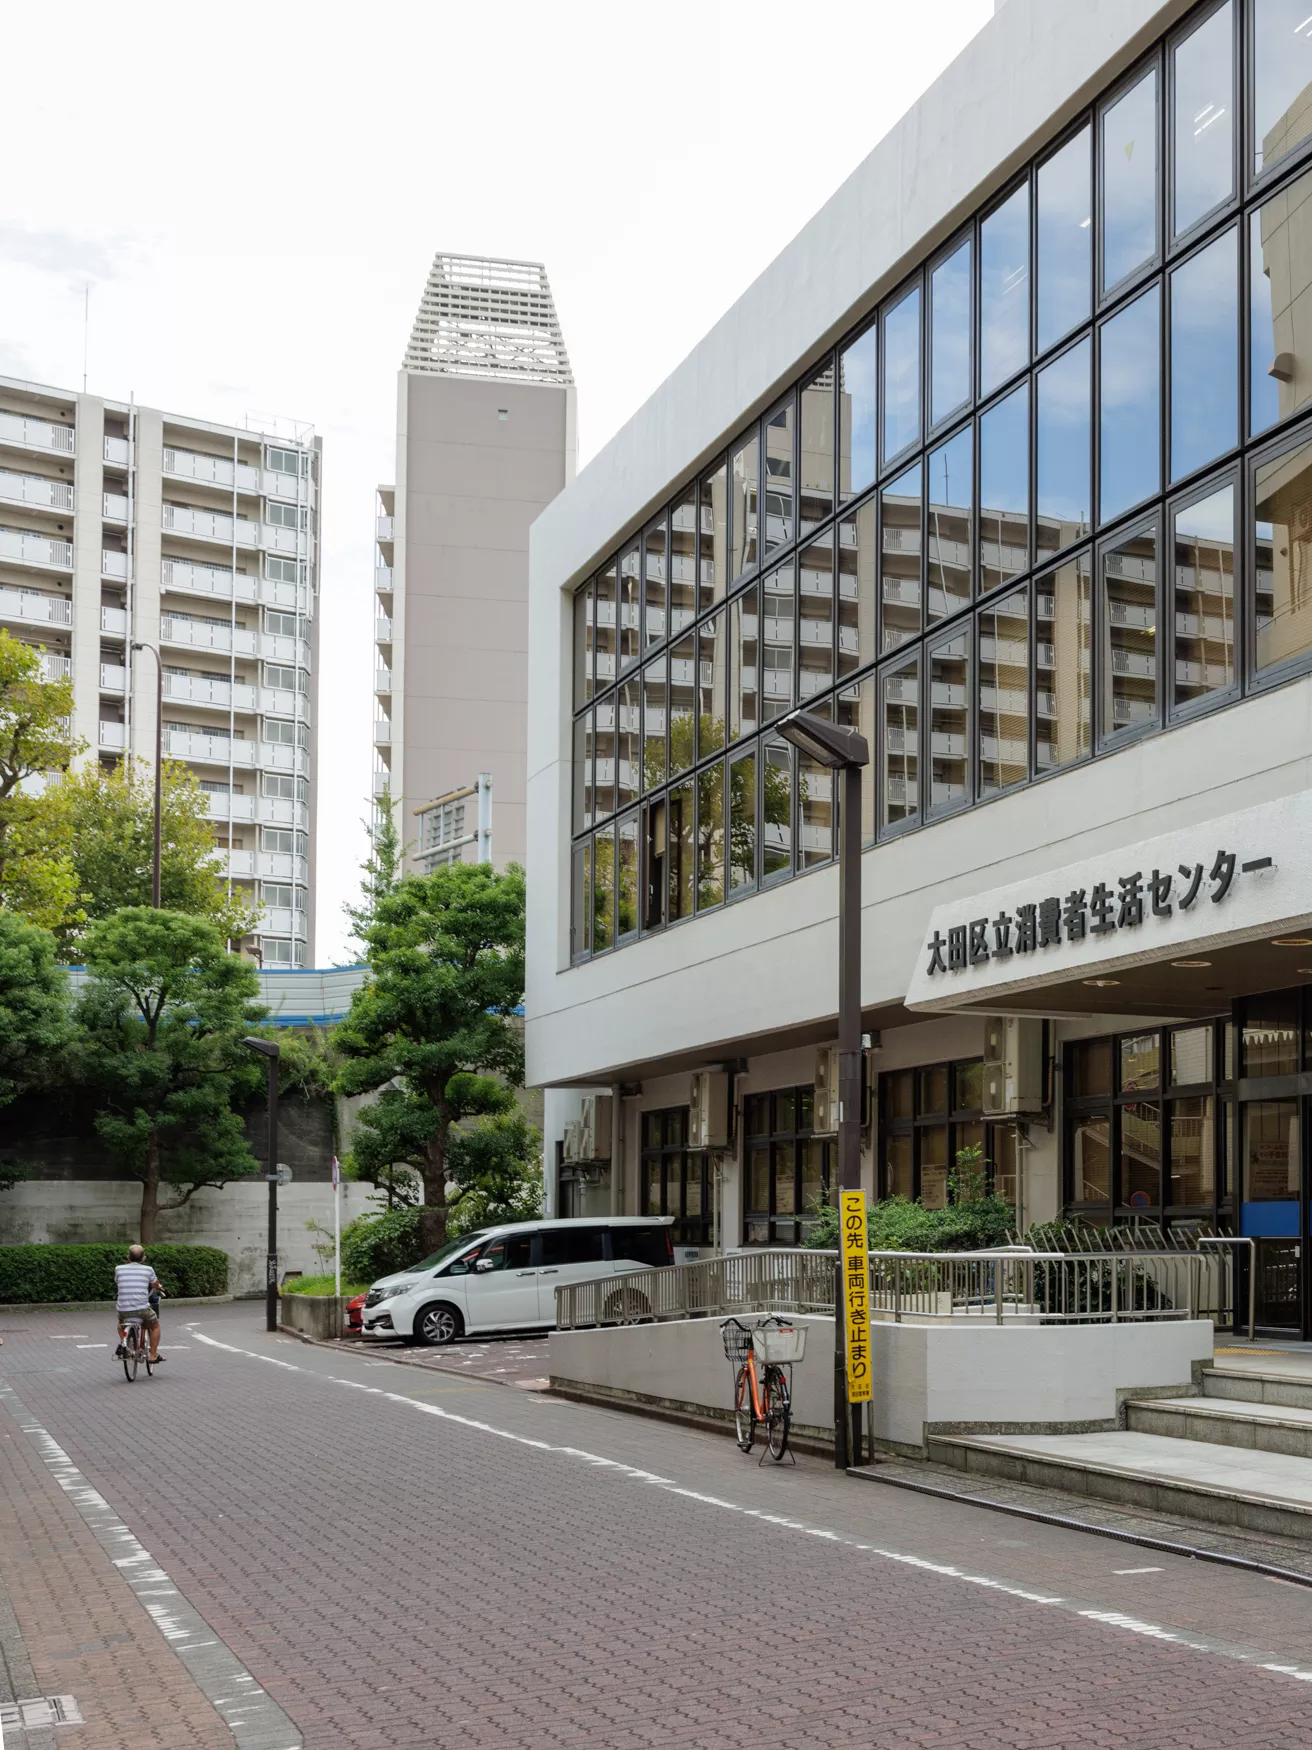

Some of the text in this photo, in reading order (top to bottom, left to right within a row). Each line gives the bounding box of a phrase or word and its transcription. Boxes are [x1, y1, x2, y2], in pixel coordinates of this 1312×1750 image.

[927, 850, 1273, 976] 大田区立消費者生活センター
[846, 1197, 867, 1379] この先 車両行き止まり
